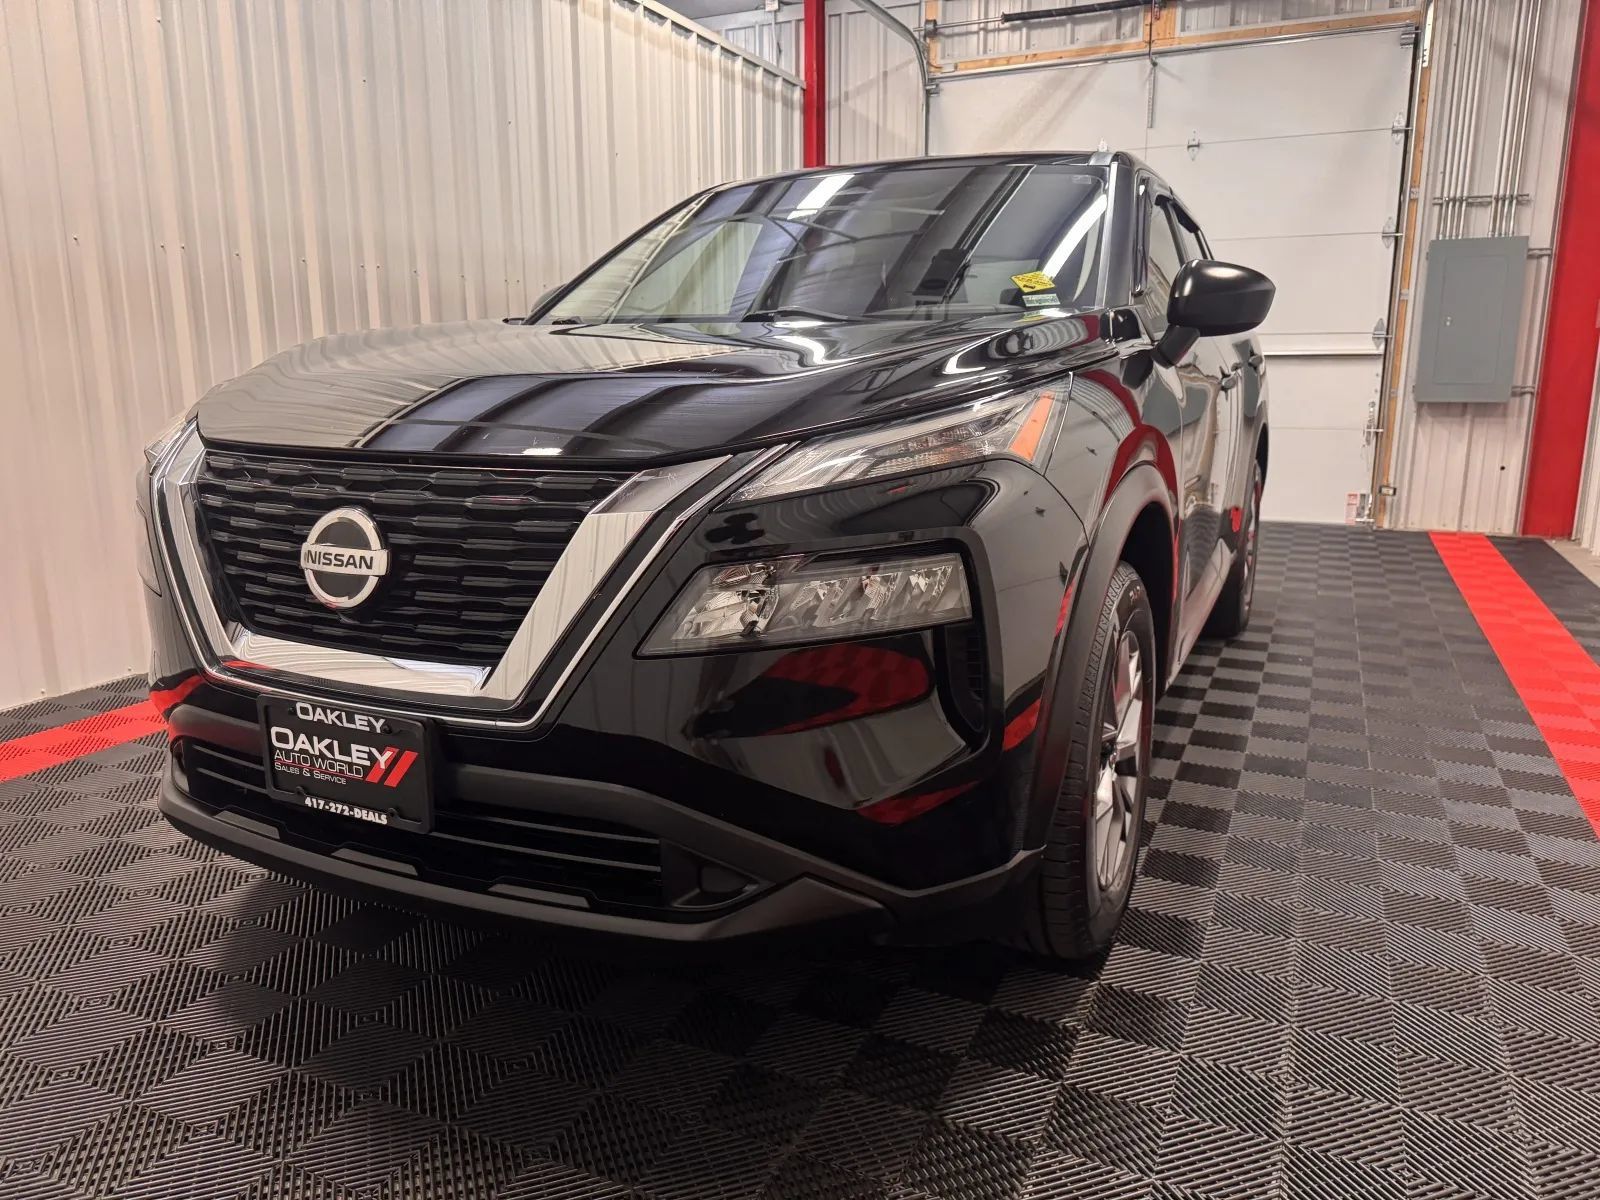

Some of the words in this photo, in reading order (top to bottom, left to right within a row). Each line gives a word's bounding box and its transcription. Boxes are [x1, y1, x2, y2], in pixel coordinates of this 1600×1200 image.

[307, 549, 374, 570] NISSAN
[295, 702, 386, 733] OAKLEY
[270, 726, 394, 769] OAKLEY
[274, 749, 311, 767] AUTO
[313, 756, 364, 778] WORLD
[302, 767, 311, 777] &
[304, 796, 388, 825] 417-272-DEALS
